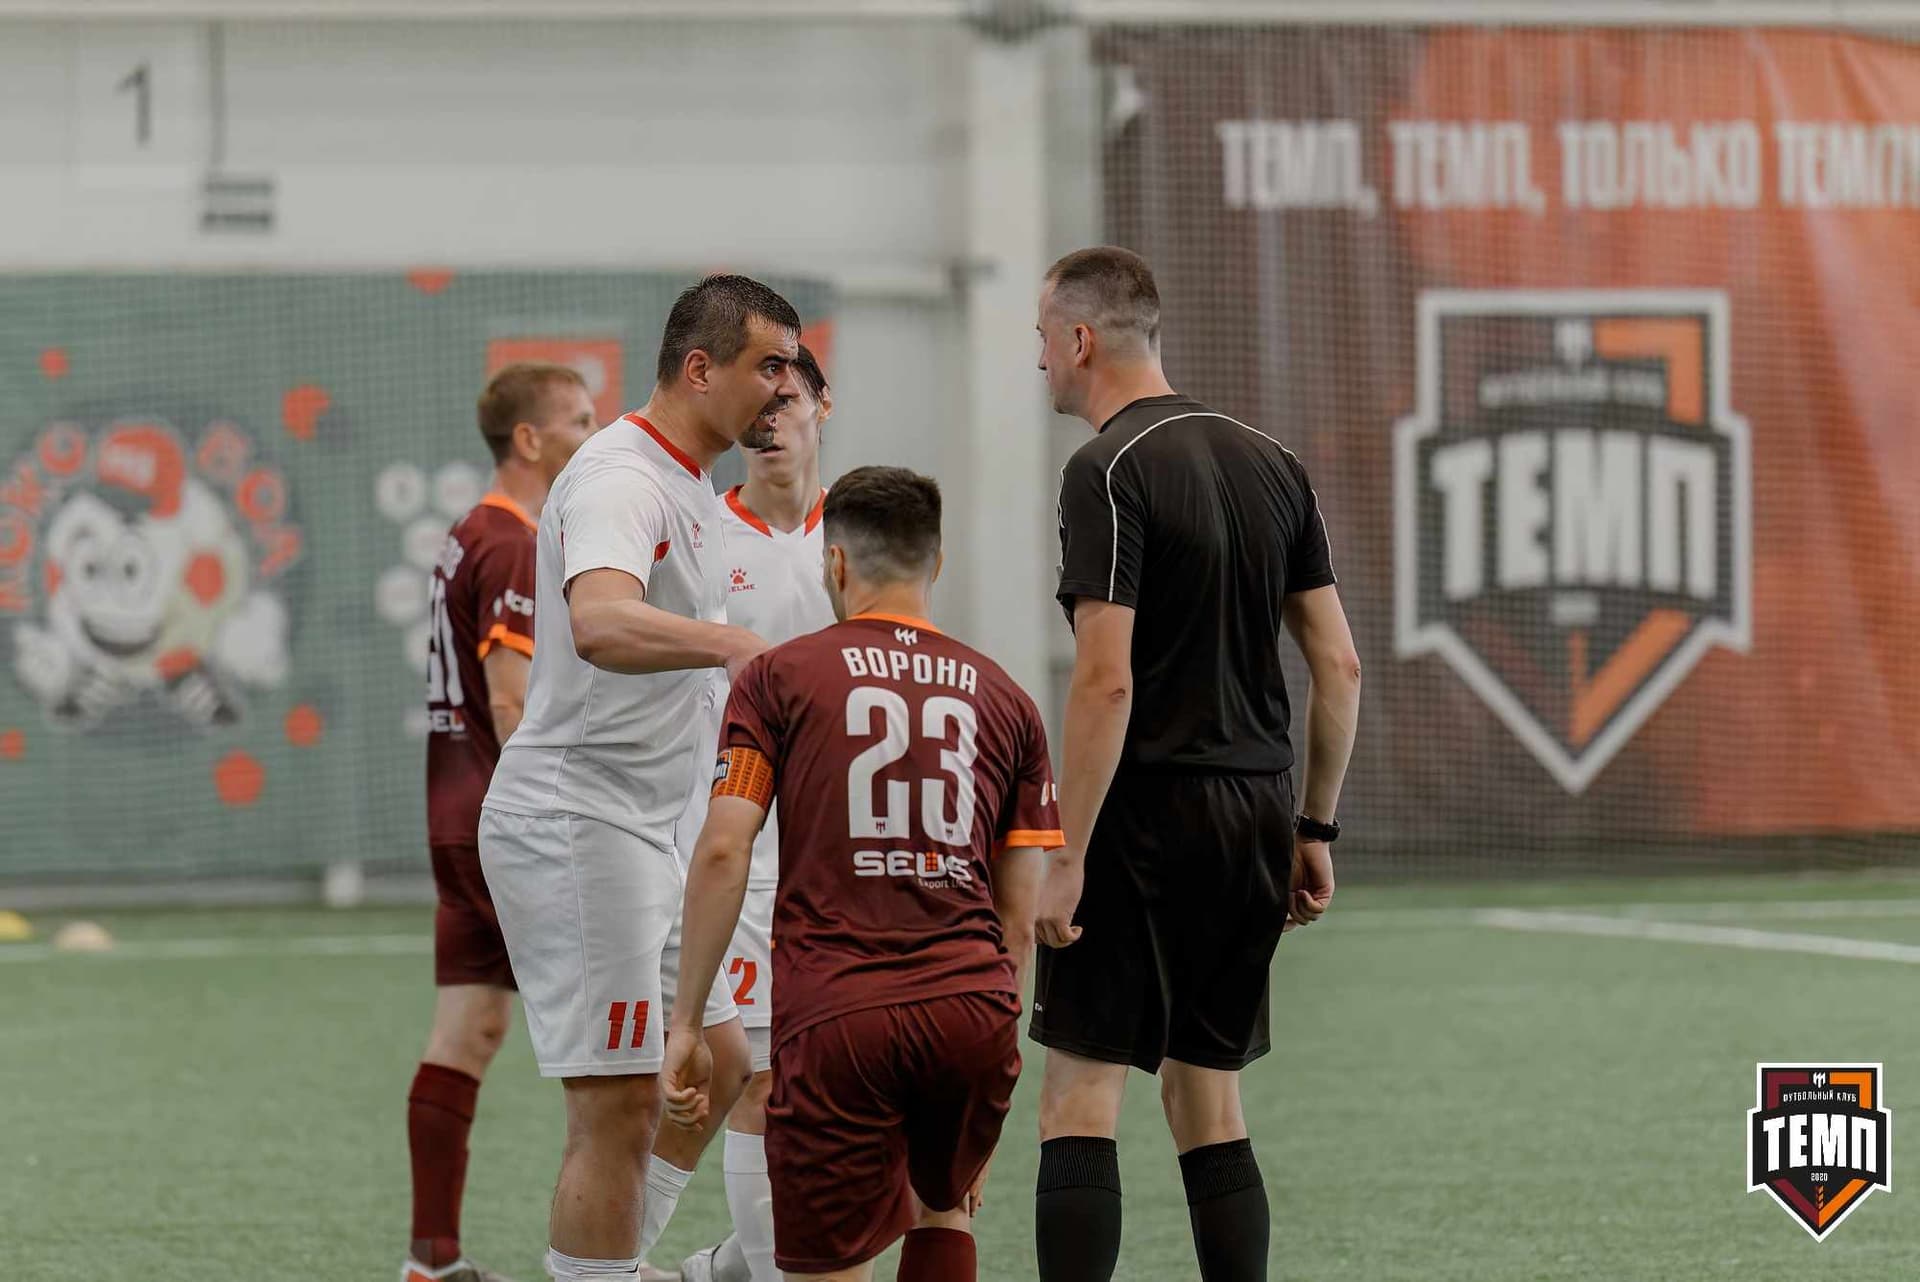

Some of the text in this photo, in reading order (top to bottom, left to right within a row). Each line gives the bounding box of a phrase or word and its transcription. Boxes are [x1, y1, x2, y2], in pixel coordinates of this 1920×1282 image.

[116, 62, 150, 147] 1
[1558, 119, 1761, 210] ТОЛЬКО
[1430, 428, 1717, 601] ТЕМП
[841, 647, 978, 695] ВОРОНА
[846, 686, 978, 847] 23
[853, 850, 972, 881] SEUS
[607, 1000, 649, 1050] 11
